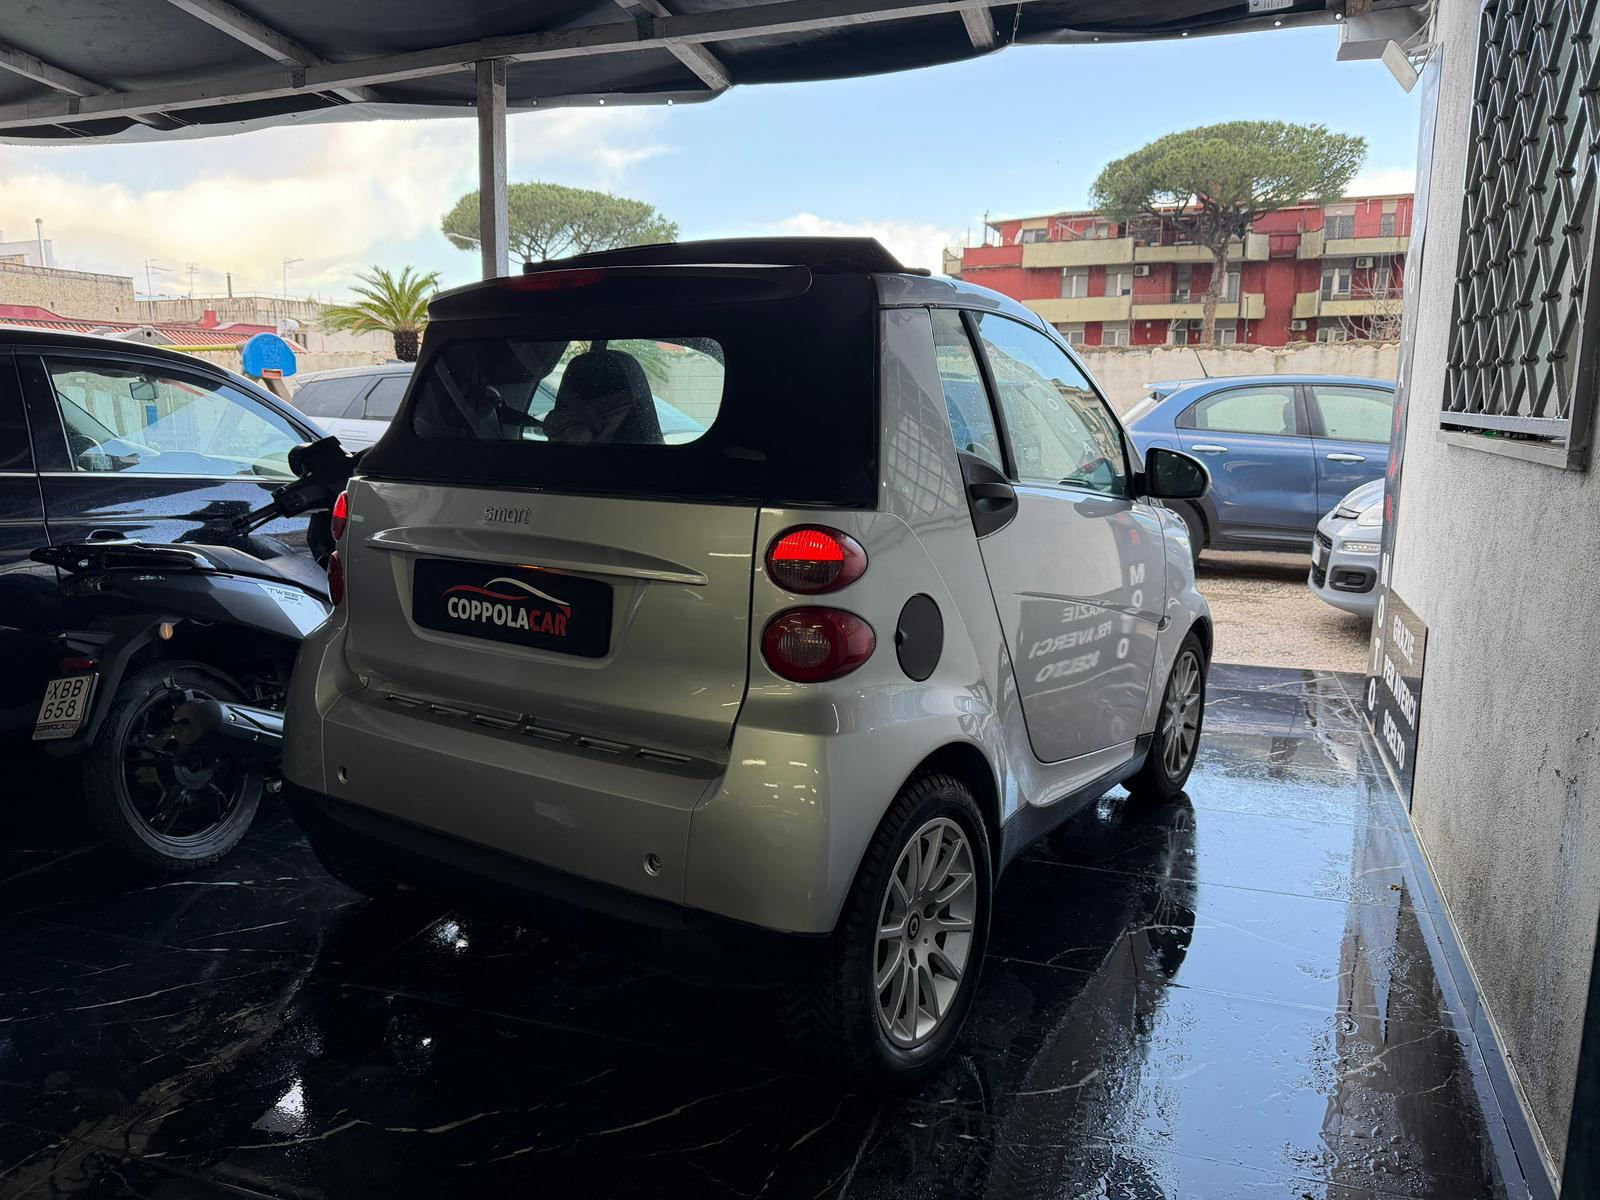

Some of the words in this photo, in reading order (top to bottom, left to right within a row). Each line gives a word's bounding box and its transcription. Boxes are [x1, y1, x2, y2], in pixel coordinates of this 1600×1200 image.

[483, 505, 531, 525] smart
[267, 587, 305, 601] TWEET
[447, 597, 568, 637] COPPOLACAR
[1367, 552, 1390, 712] MOTO
[1393, 614, 1415, 666] GRAZIE
[50, 679, 84, 700] XBB
[1383, 654, 1396, 693] PER
[1393, 675, 1417, 730] AVERCI
[44, 700, 77, 720] 658
[1383, 709, 1405, 770] SCELTO
